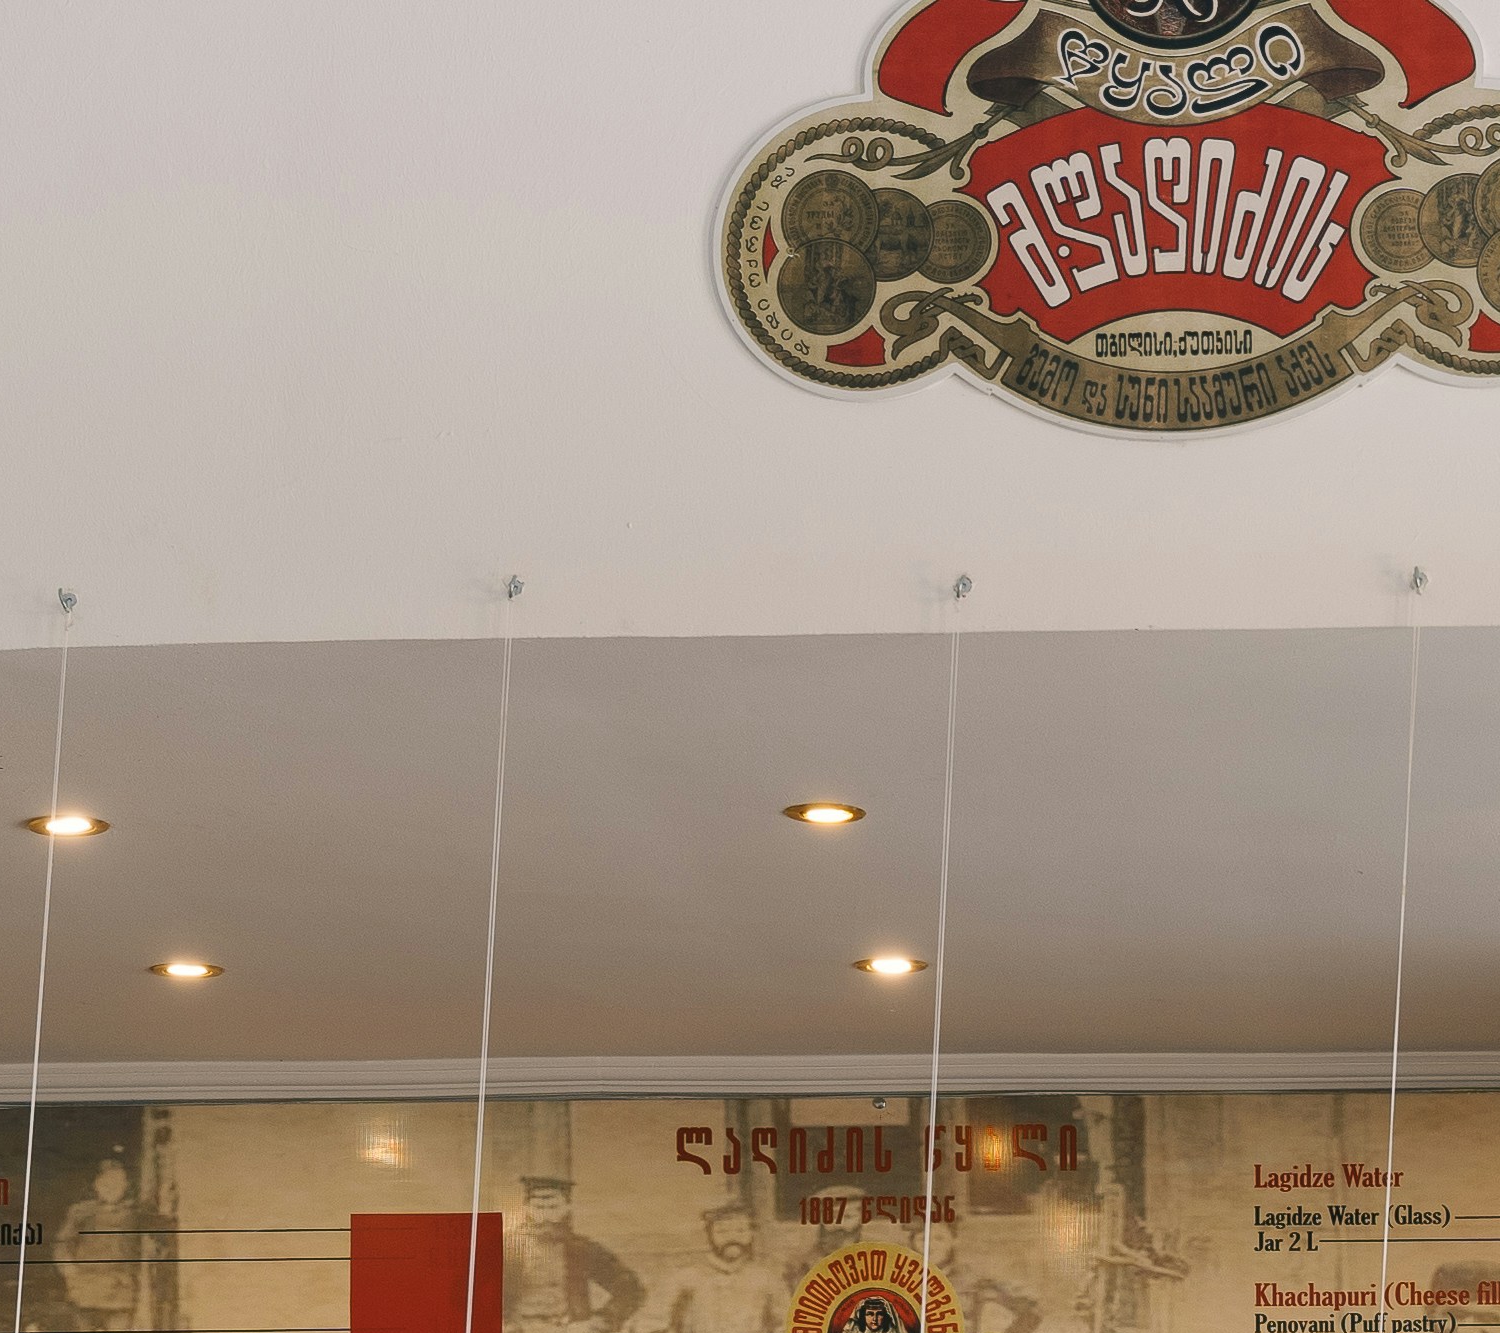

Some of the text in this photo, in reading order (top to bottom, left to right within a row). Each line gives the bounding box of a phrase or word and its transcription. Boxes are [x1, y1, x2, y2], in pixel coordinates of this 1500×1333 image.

[1082, 380, 1108, 416] და
[676, 1124, 1077, 1175] ლაღიძის წყალი
[1254, 1163, 1403, 1192] Lagidze Water
[1254, 1204, 1451, 1229] Lagidze Water (Glass)
[1254, 1231, 1318, 1253] Jar 2 L
[1255, 1283, 1377, 1311] Khachapuri
[1384, 1281, 1469, 1309] (Cheese
[1255, 1314, 1335, 1333] Penovani
